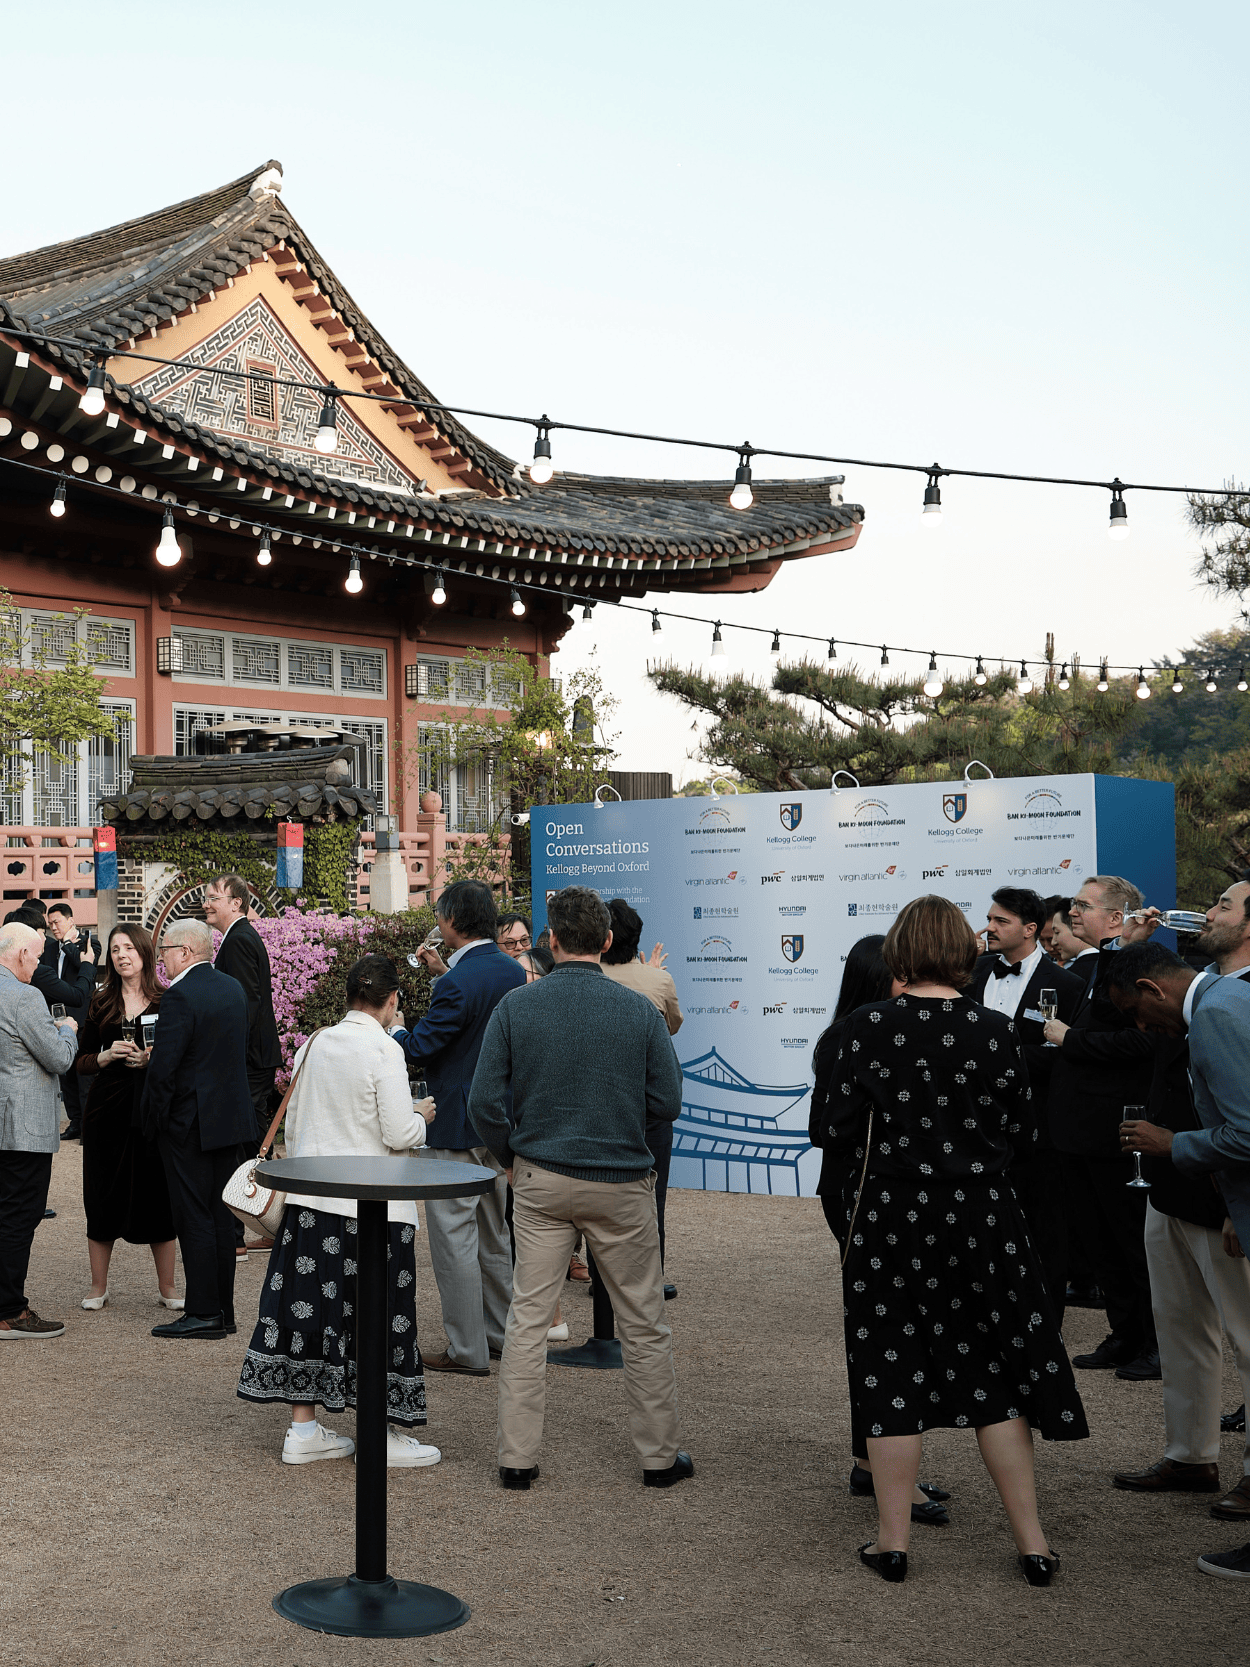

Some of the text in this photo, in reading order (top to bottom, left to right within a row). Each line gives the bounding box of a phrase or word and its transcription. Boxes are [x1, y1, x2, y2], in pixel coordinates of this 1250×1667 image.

[1045, 810, 1081, 818] FOUNDATION
[546, 822, 584, 839] Open
[928, 829, 955, 837] Kellogg
[546, 840, 650, 857] Conversations
[546, 861, 650, 876] Kellogg Beyond Oxford
[1008, 867, 1062, 877] virgin atlantic
[839, 872, 888, 882] virgin atlantic
[922, 870, 944, 880] pwc
[761, 876, 781, 885] pwc
[631, 886, 642, 894] the
[794, 967, 818, 975] College
[763, 1006, 783, 1016] pwc
